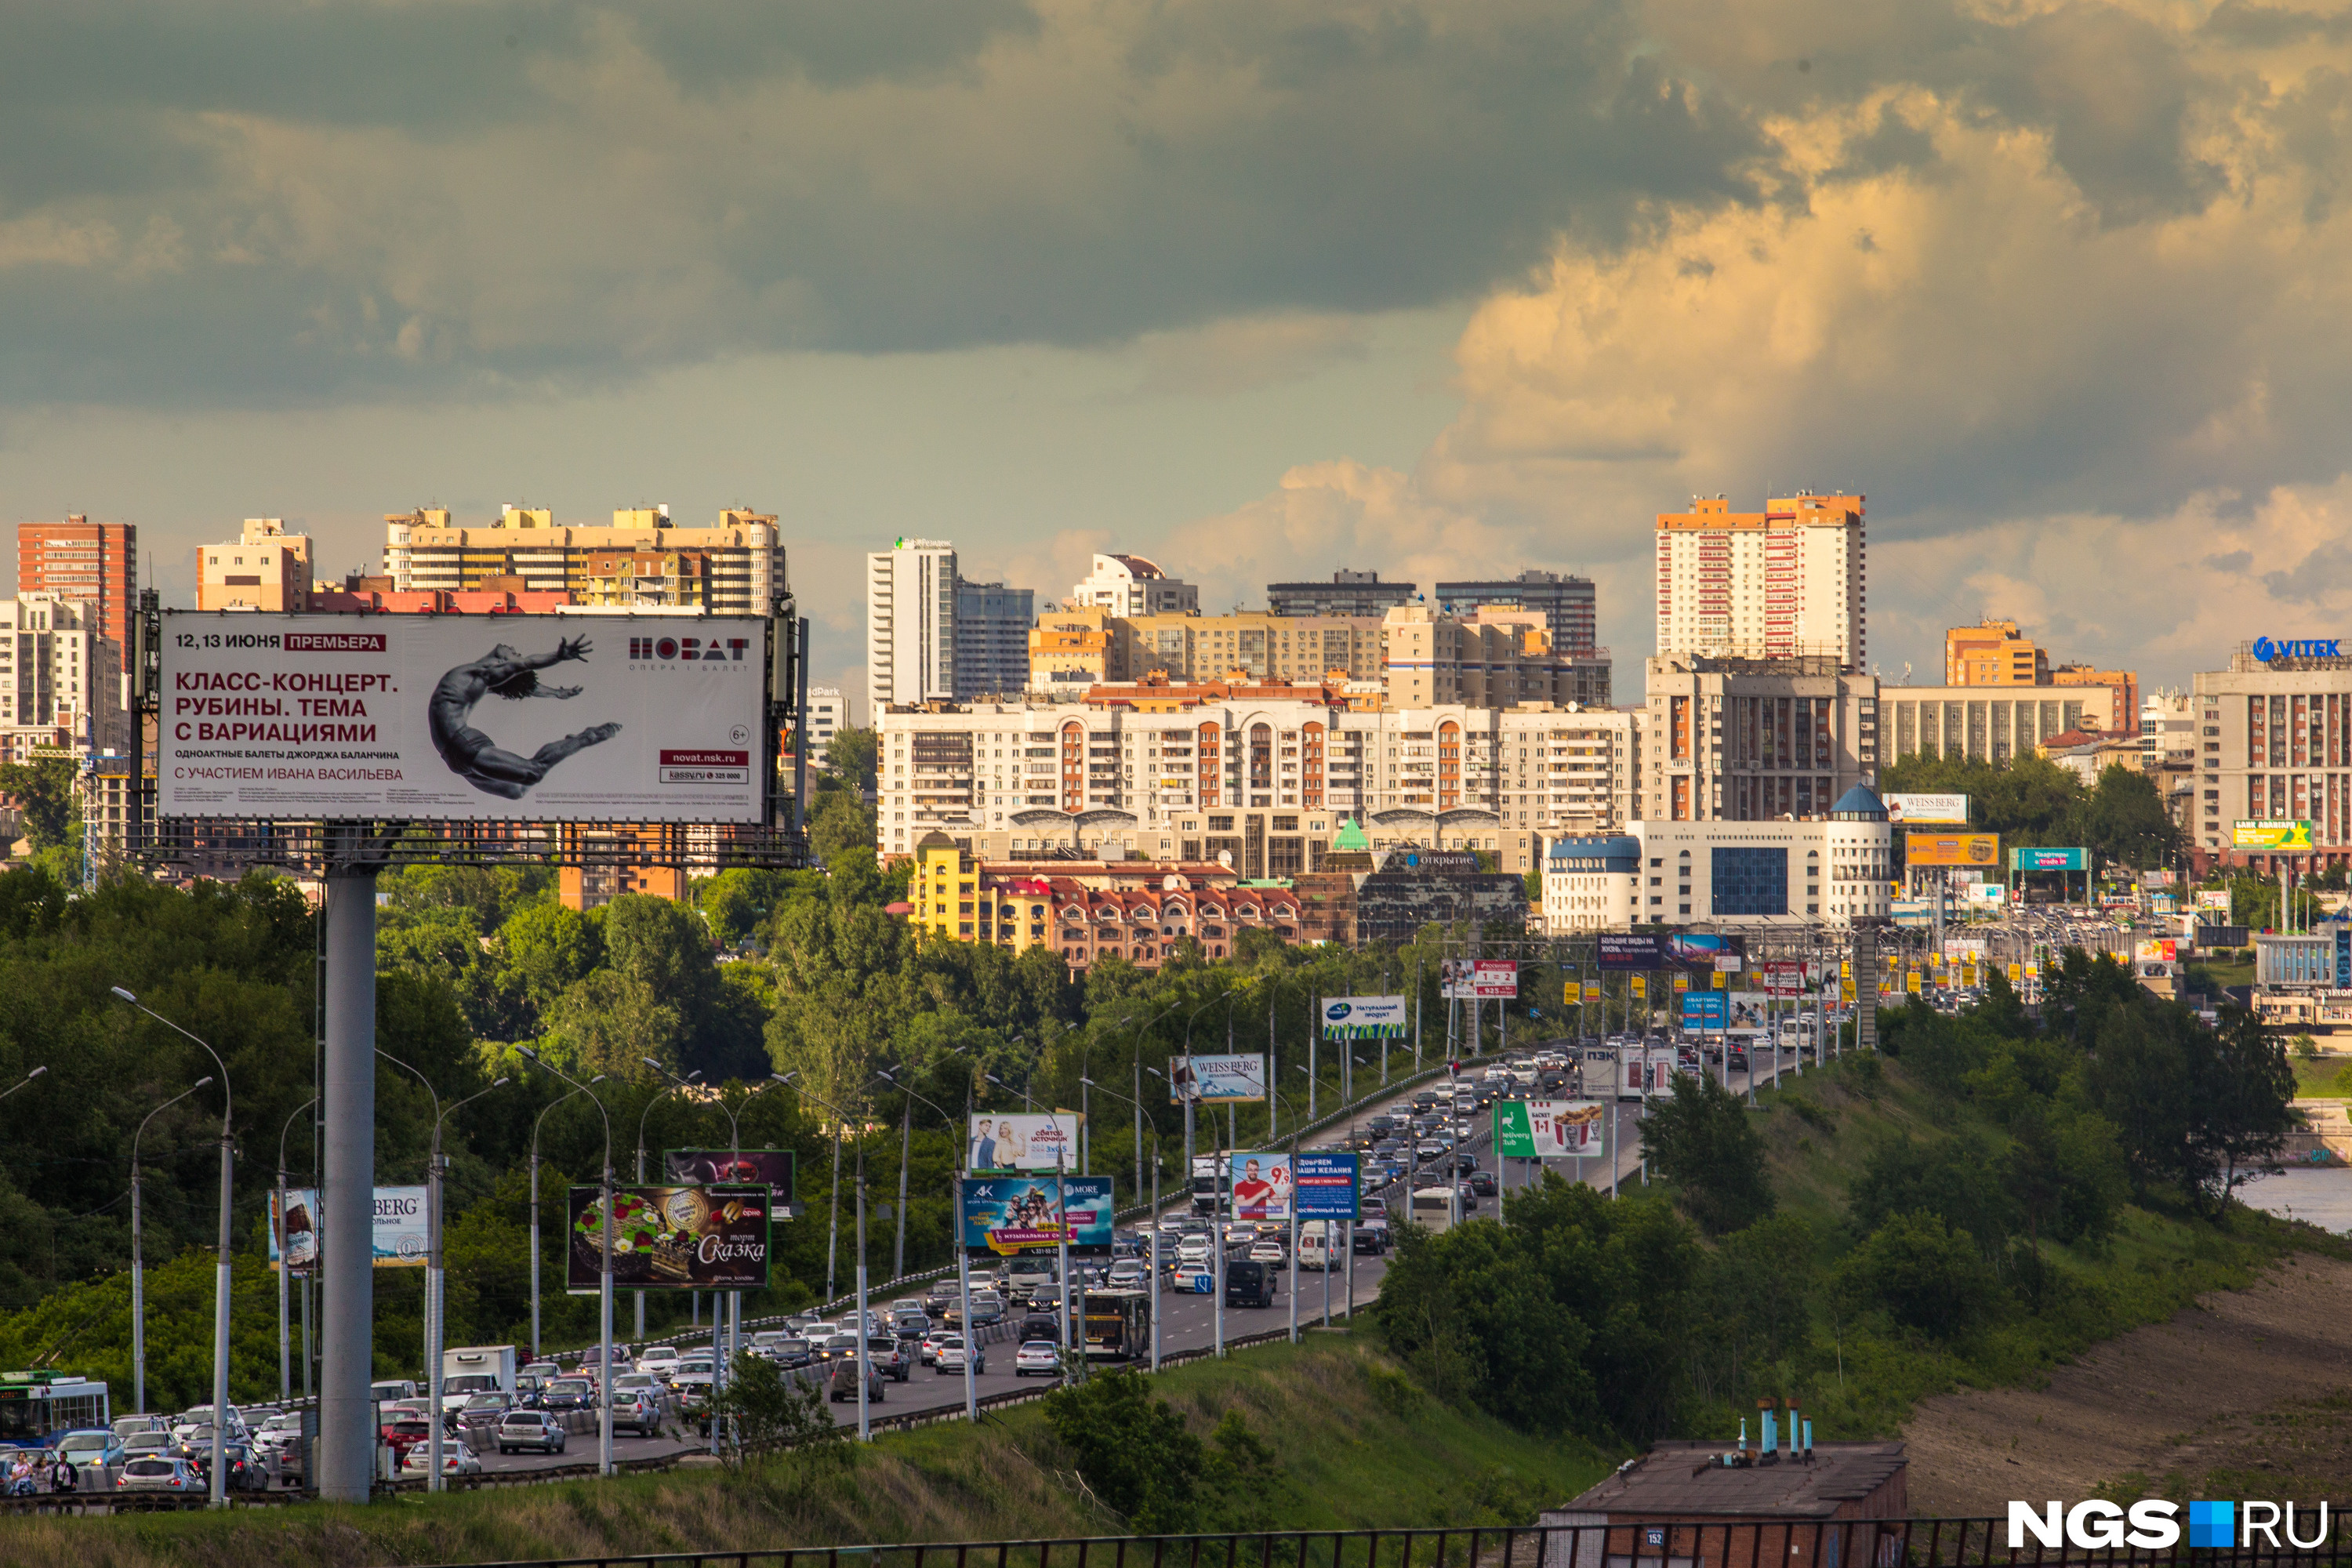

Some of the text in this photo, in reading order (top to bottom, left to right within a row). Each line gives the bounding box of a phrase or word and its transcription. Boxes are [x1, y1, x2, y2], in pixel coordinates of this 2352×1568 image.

[226, 635, 280, 648] ИЮНЯ
[290, 637, 380, 649] ПРЕМЬЕРА
[630, 637, 750, 660] НОВАТ
[2278, 639, 2341, 658] VITEK
[176, 672, 398, 695] КЛАСС-КОНЦЕРТ.
[176, 698, 367, 717] РУБИНЫ. ТЕМА
[175, 722, 376, 745] С ВАРИАЦИЯМИ
[733, 730, 746, 739] 6+
[175, 750, 400, 760] ОДНОАКТНЫЕ БАЛЕТЫ ДЖОРДЖА БАЛАНЧИНА
[673, 754, 735, 763] novat.nsk.ru
[174, 768, 403, 780] С УЧАСТИЕМ ИВАНА ВАСИЛЬЕВА
[670, 771, 706, 779] kassy.ru
[1421, 856, 1474, 867] открытие
[1628, 937, 1646, 946] ВИДЫ
[1587, 1051, 1615, 1061] ПЭК
[1534, 1120, 1549, 1133] 1+1
[1074, 1185, 1098, 1194] MORE
[373, 1198, 417, 1216] BERG
[730, 1234, 755, 1243] торт
[698, 1234, 765, 1264] Сказка
[1649, 1534, 1662, 1544] 152
